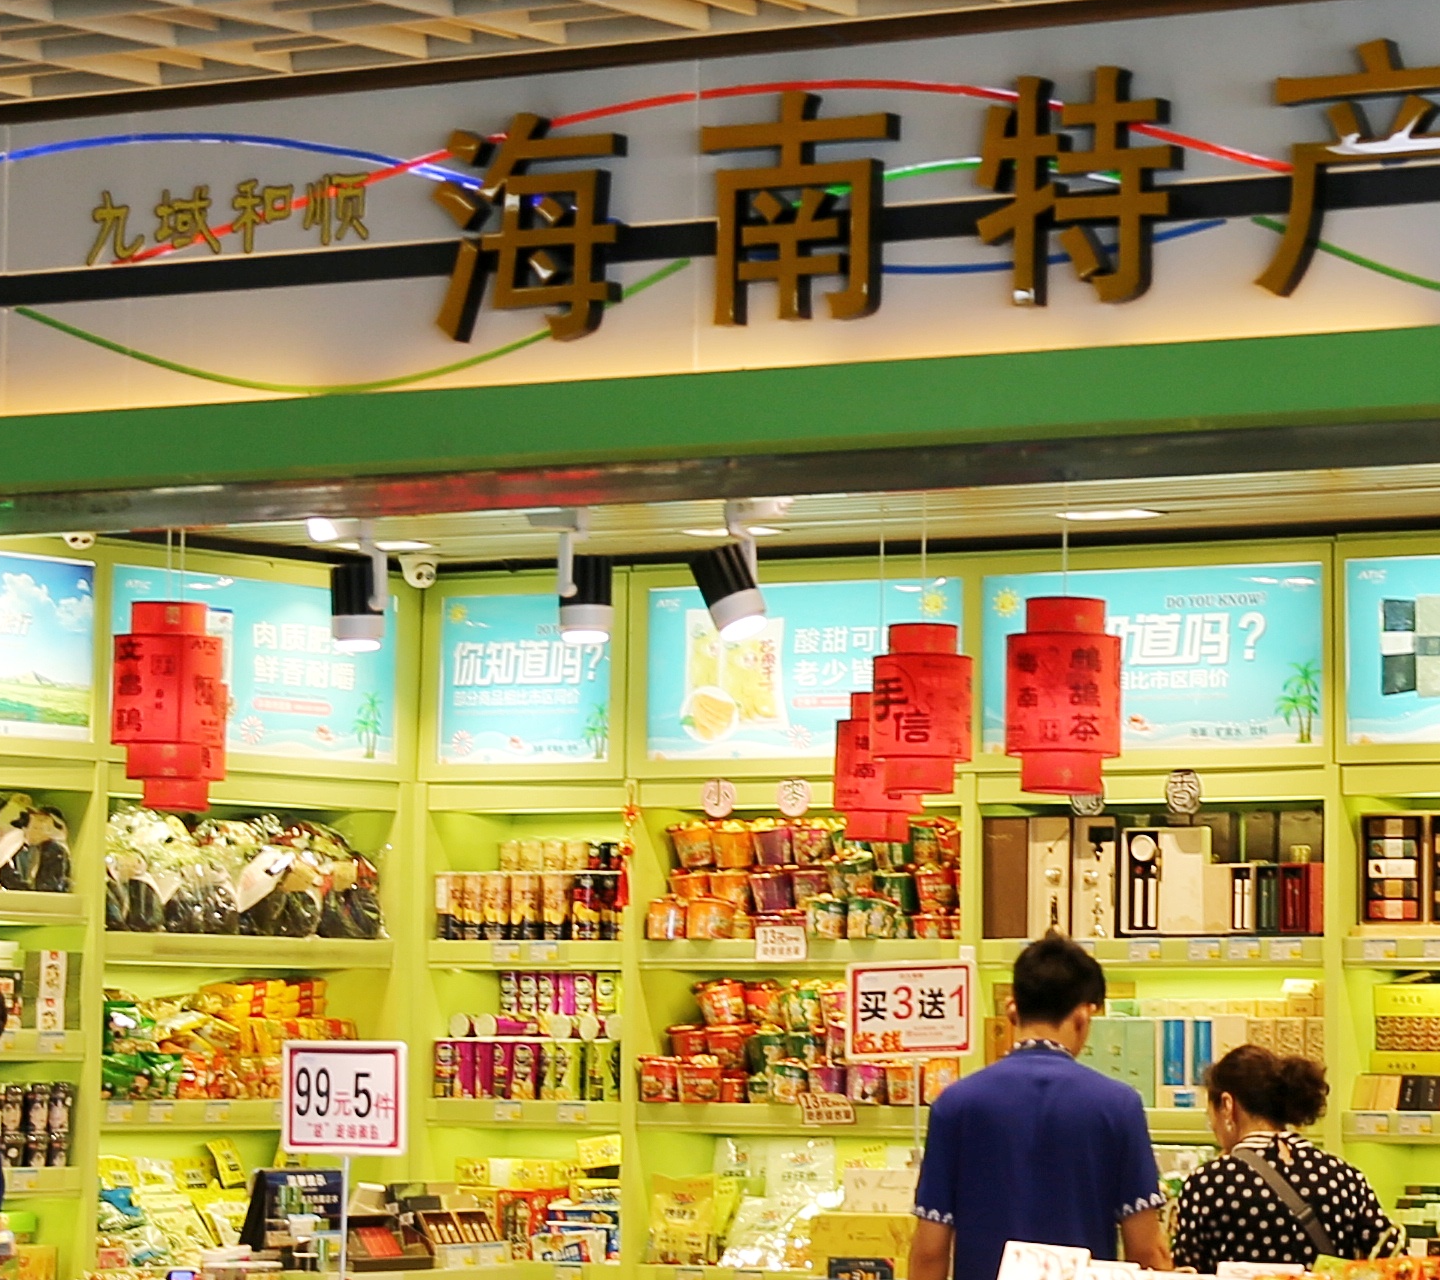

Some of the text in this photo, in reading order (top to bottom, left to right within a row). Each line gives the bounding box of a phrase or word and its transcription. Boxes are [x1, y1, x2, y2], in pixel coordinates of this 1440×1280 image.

[86, 173, 371, 266] 九域和顺
[859, 984, 965, 1023] 买3送1
[296, 1067, 394, 1118] 99元5件
